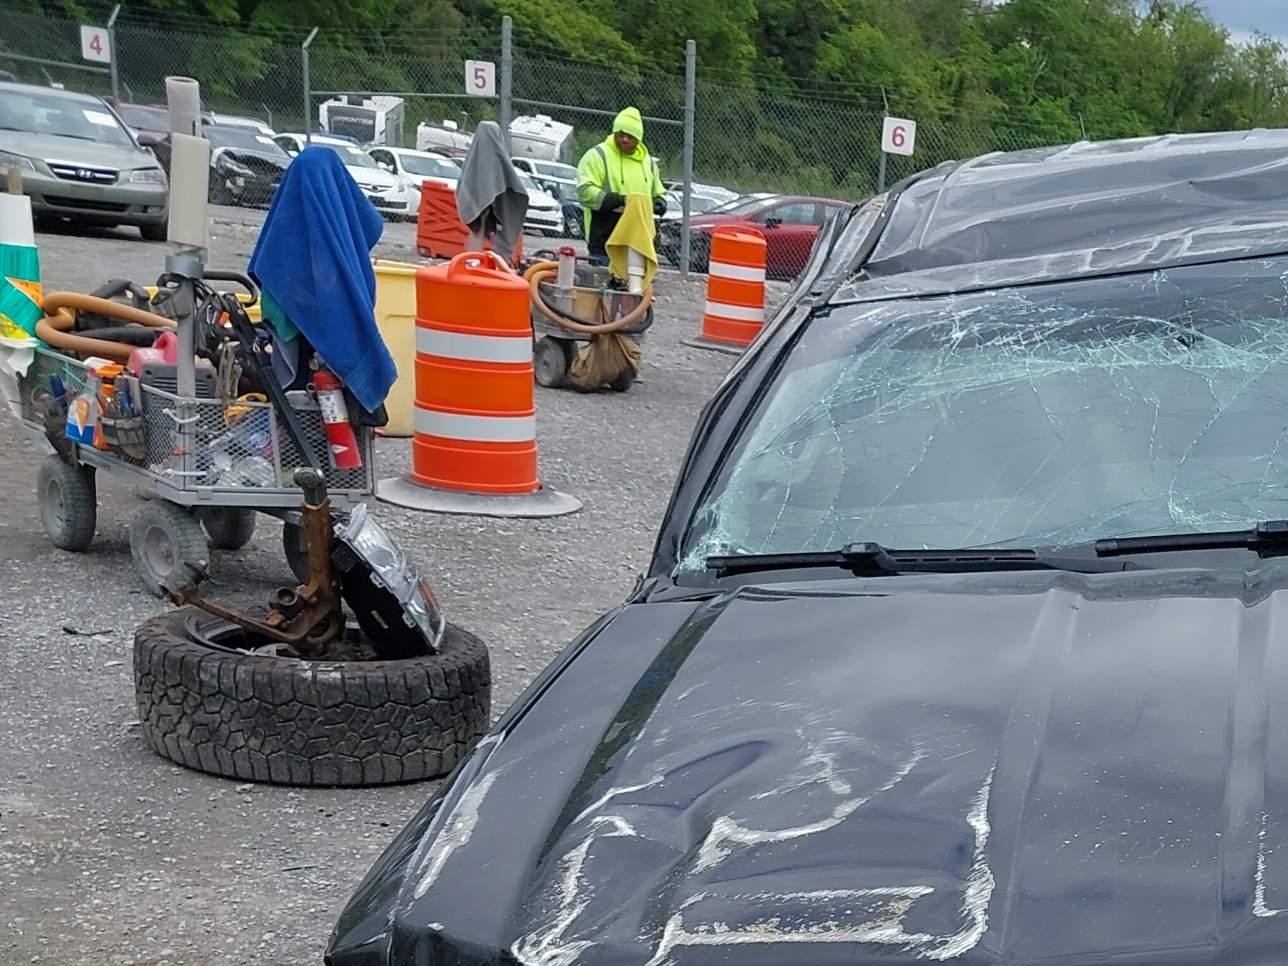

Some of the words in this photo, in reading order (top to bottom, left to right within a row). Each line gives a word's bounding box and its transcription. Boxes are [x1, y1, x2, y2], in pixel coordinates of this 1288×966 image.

[89, 34, 103, 55] 4
[474, 67, 487, 89] 5
[892, 126, 906, 147] 6
